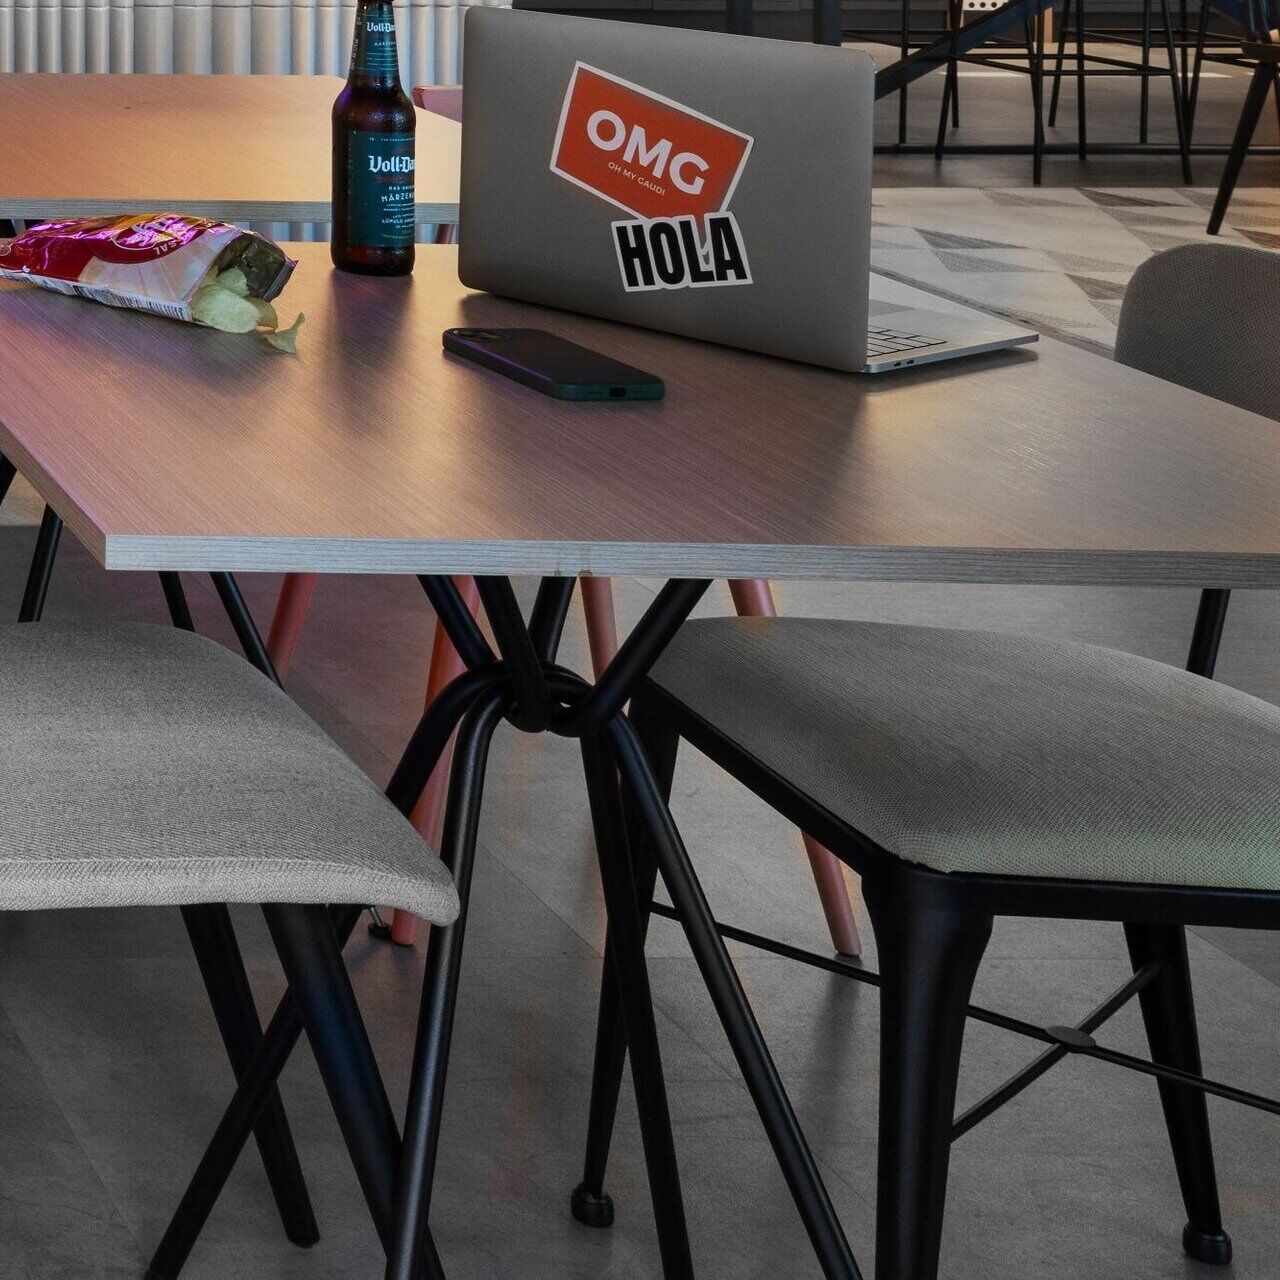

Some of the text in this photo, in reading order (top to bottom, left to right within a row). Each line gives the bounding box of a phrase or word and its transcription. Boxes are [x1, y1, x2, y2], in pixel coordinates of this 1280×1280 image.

[586, 109, 710, 195] OMG
[608, 161, 666, 196] OH MY GAUDI
[615, 216, 748, 288] HOLA
